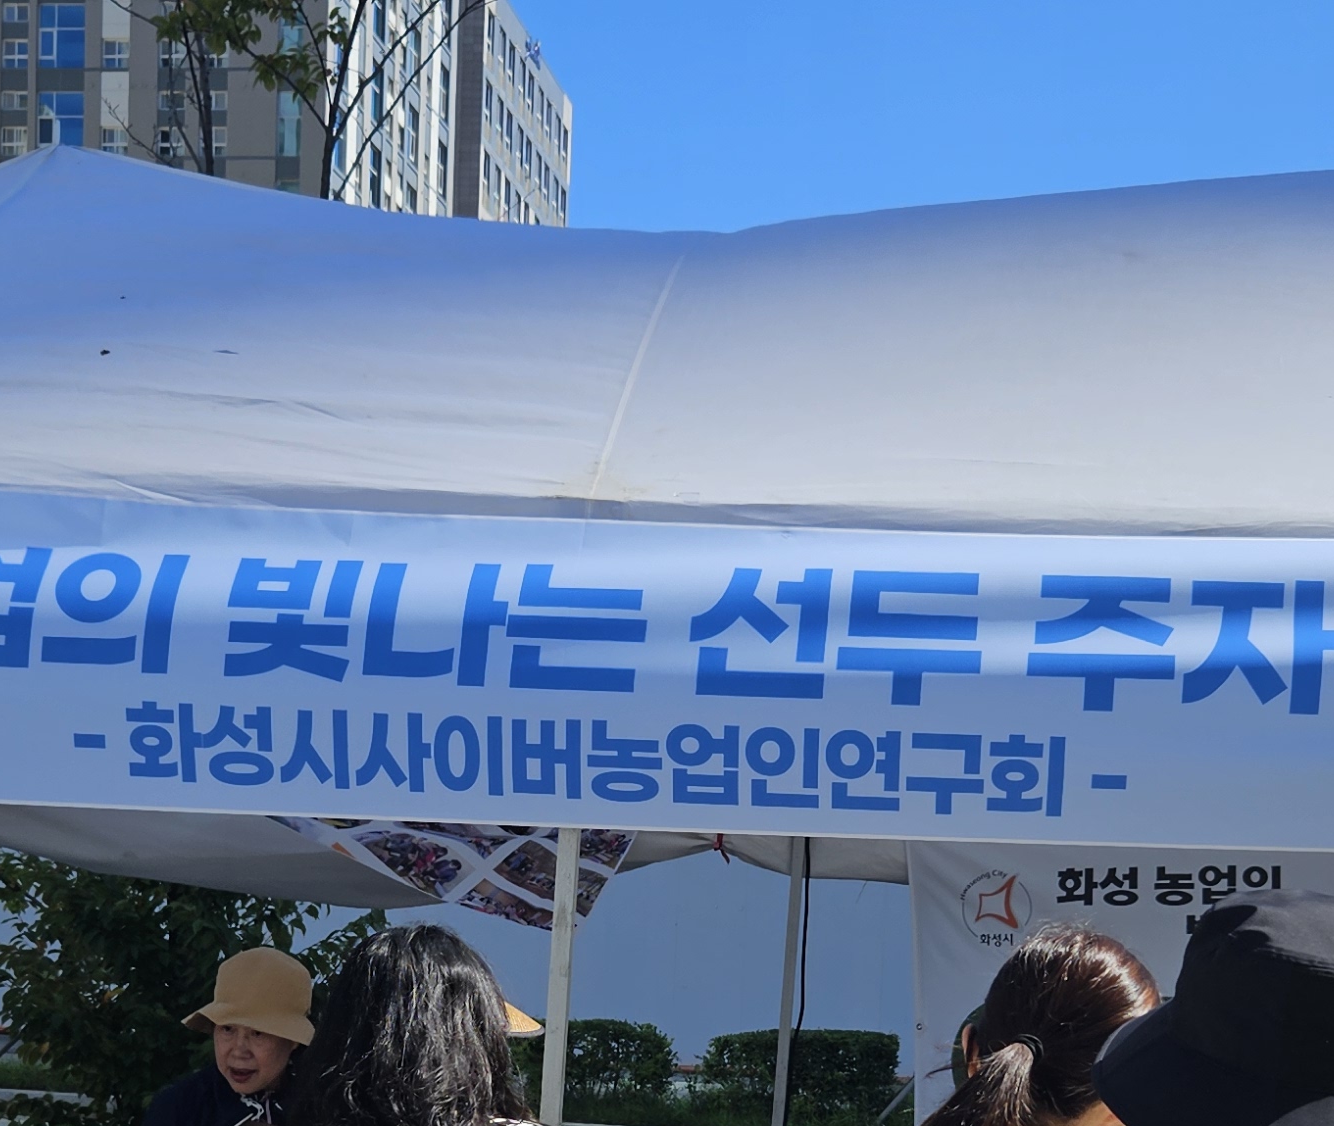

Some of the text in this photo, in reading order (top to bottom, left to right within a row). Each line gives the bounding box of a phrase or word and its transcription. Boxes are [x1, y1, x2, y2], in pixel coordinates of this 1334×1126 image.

[223, 557, 648, 693] 빛나는
[689, 567, 984, 707] 선두
[125, 702, 1067, 818] 화성시사이버농업인연구회
[960, 869, 1008, 901] Hwaseong City
[1056, 867, 1139, 907] 화성
[980, 933, 1014, 947] 화성시
